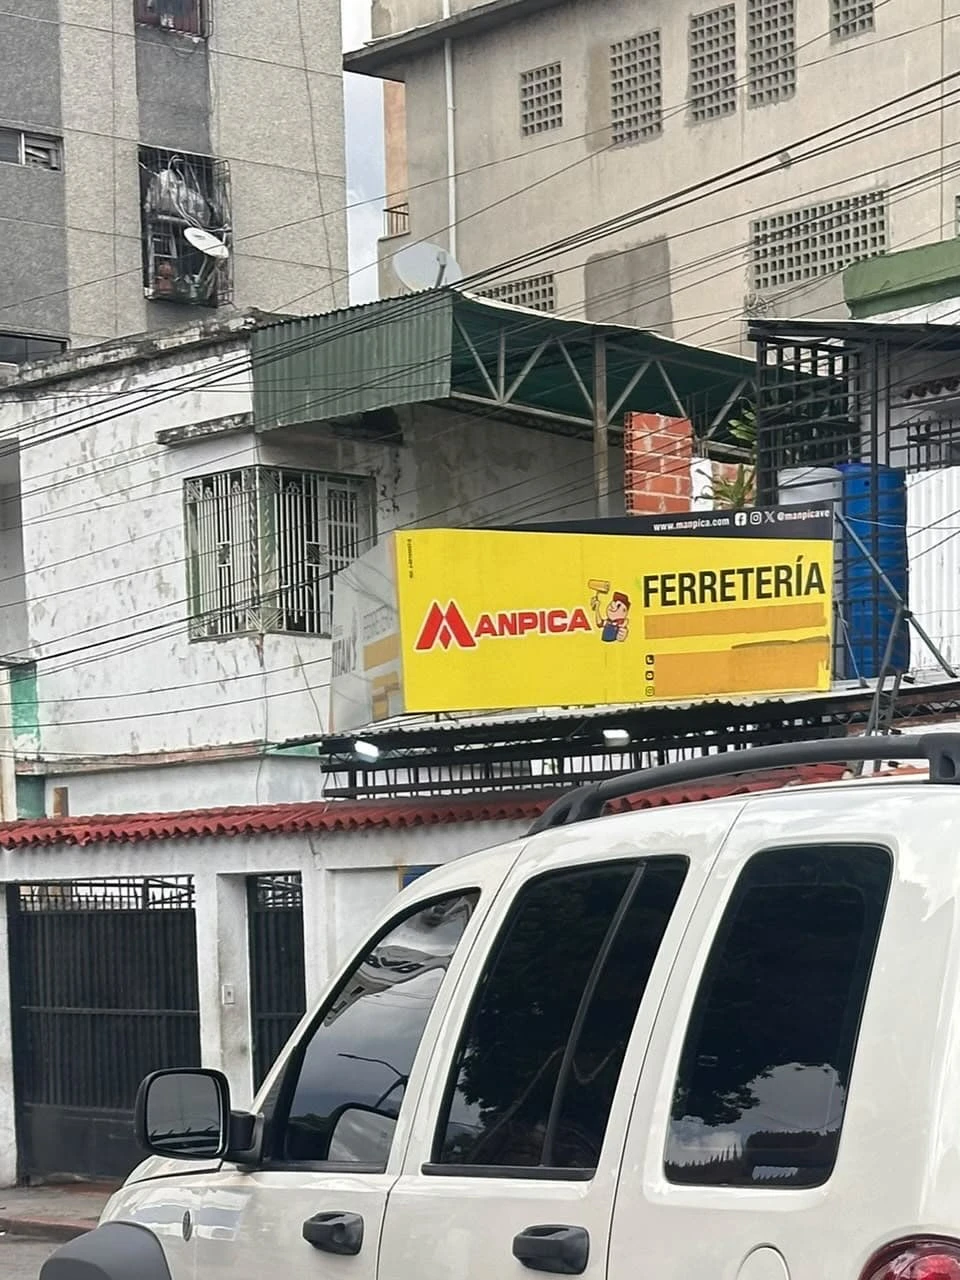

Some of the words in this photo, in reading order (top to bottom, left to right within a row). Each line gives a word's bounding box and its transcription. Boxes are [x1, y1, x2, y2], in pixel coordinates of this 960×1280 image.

[653, 517, 730, 531] www.manpica.com
[777, 509, 830, 521] @manpicave
[643, 554, 826, 608] FERRETERÍA
[416, 600, 592, 650] MANPICA
